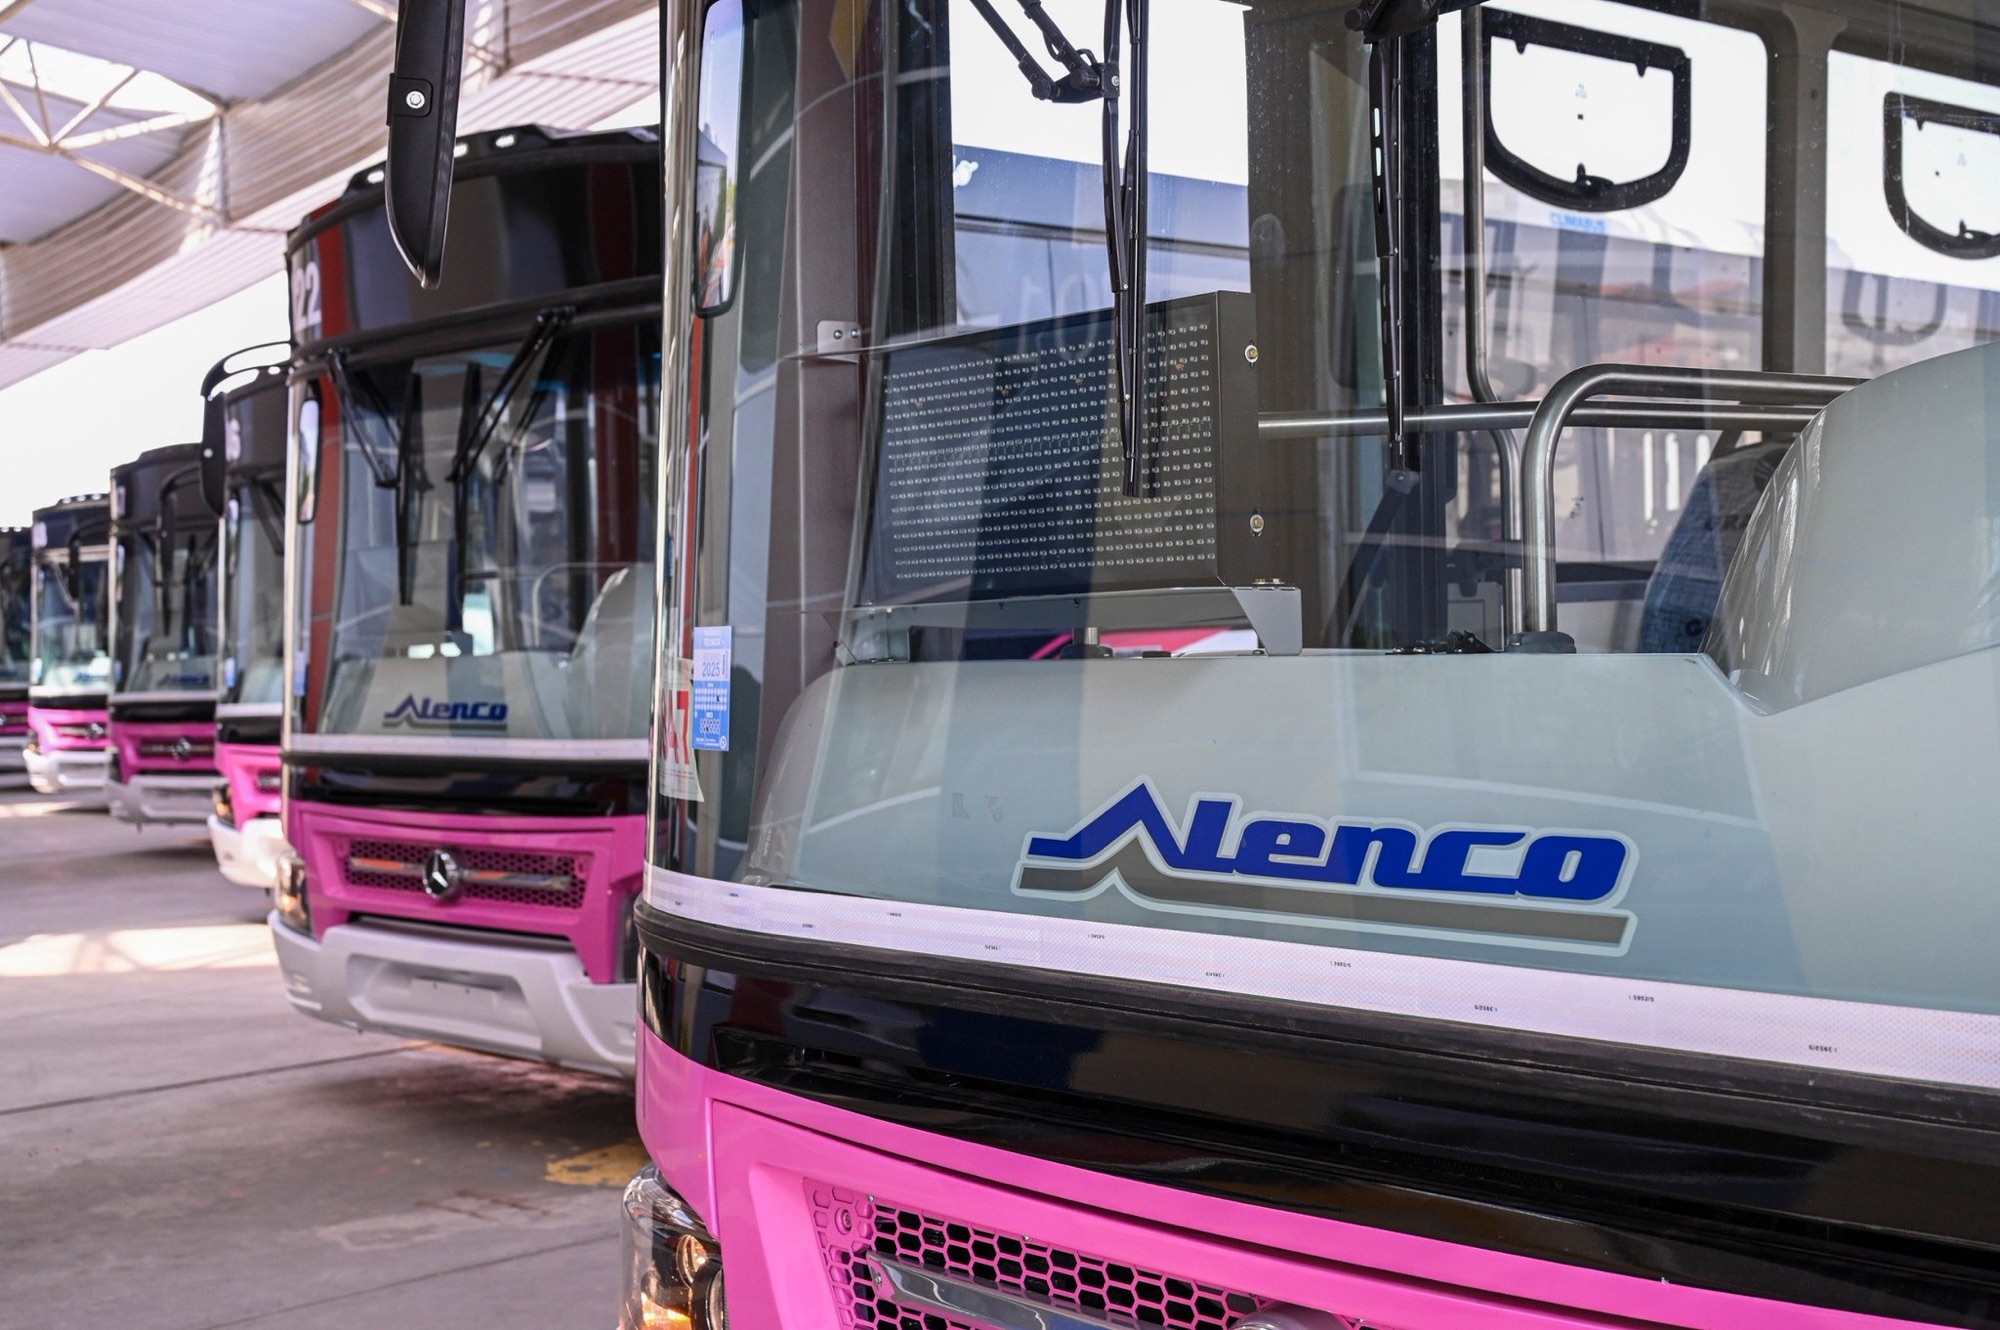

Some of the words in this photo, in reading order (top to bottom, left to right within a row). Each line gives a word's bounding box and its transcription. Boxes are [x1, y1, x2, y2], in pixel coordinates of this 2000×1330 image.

[702, 661, 720, 677] 2025
[383, 693, 508, 721] Alenco
[1026, 780, 1629, 902] Alenco
